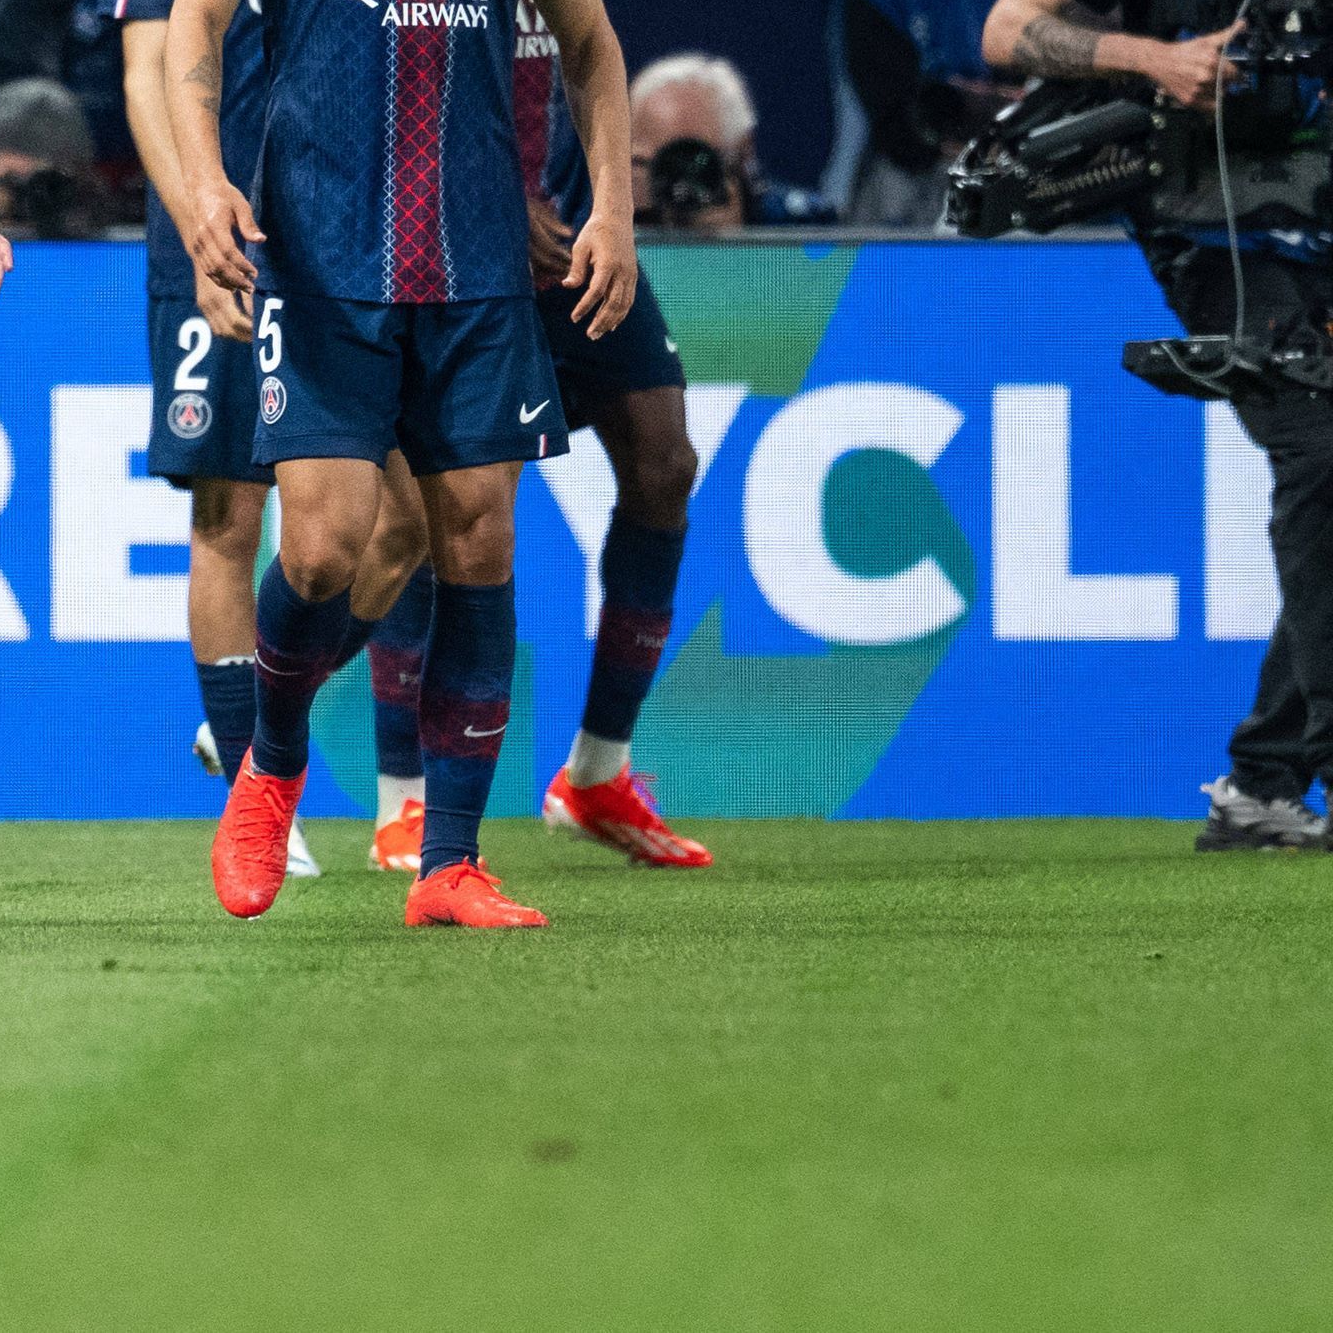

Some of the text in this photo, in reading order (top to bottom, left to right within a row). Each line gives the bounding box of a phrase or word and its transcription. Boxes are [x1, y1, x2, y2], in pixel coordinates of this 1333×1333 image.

[381, 2, 488, 30] AIRWAYS
[172, 315, 213, 391] 2
[258, 298, 285, 373] 5
